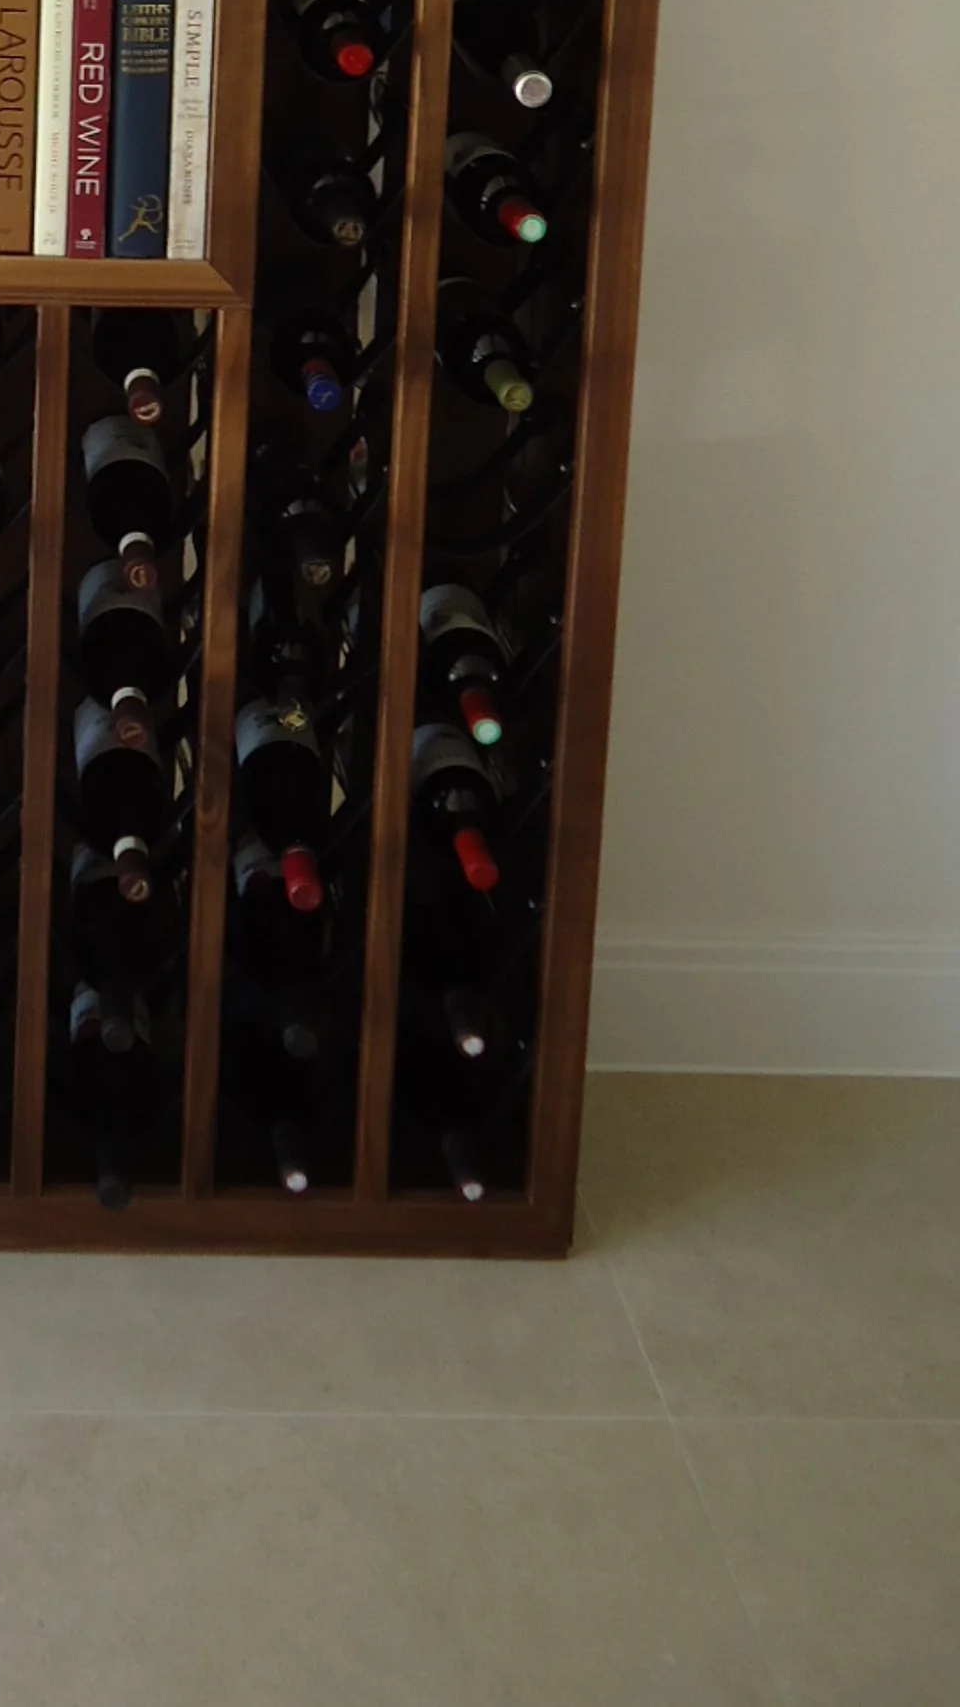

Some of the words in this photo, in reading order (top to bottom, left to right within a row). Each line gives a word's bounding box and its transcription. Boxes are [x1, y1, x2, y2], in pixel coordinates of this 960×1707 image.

[78, 42, 105, 106] RED
[184, 9, 202, 89] SIMPLE
[75, 114, 102, 197] WINE
